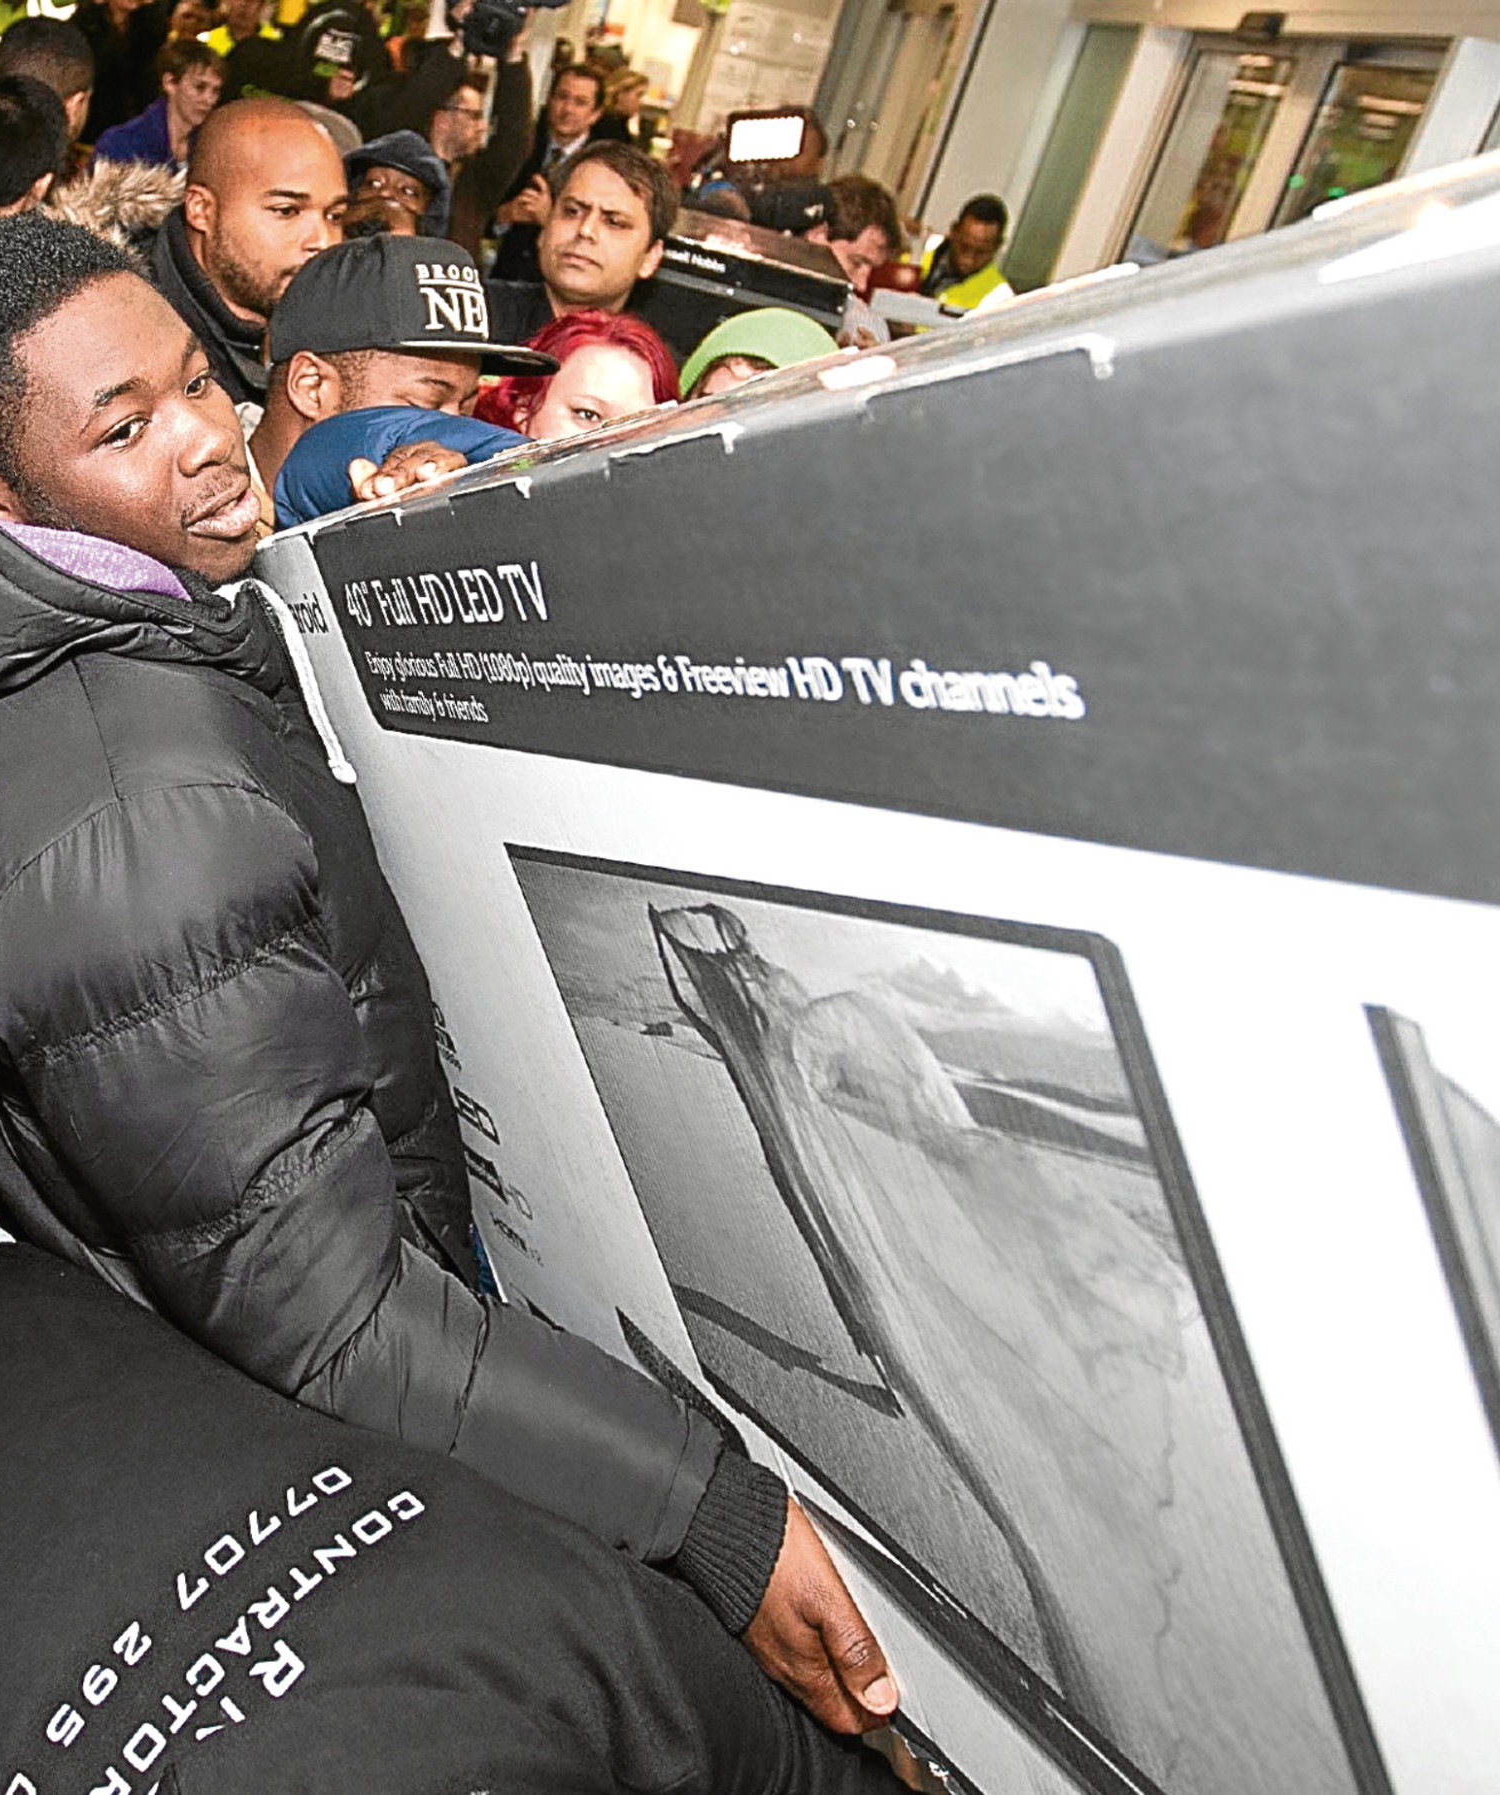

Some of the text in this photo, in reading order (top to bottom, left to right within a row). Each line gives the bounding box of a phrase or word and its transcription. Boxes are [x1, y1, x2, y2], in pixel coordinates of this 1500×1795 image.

[415, 264, 480, 284] BROO
[419, 287, 489, 339] NE
[287, 592, 330, 634] roid
[370, 578, 418, 626] Full
[407, 573, 453, 625] HD
[444, 568, 504, 623] LED
[496, 561, 548, 621] TV
[364, 651, 1087, 719] Enjoy glorious Full HD (1080p) quality images & Freeview HD TV channels
[379, 688, 405, 712] with
[400, 689, 436, 722] family
[442, 692, 489, 723] friends
[46, 1466, 352, 1747] 07707 295
